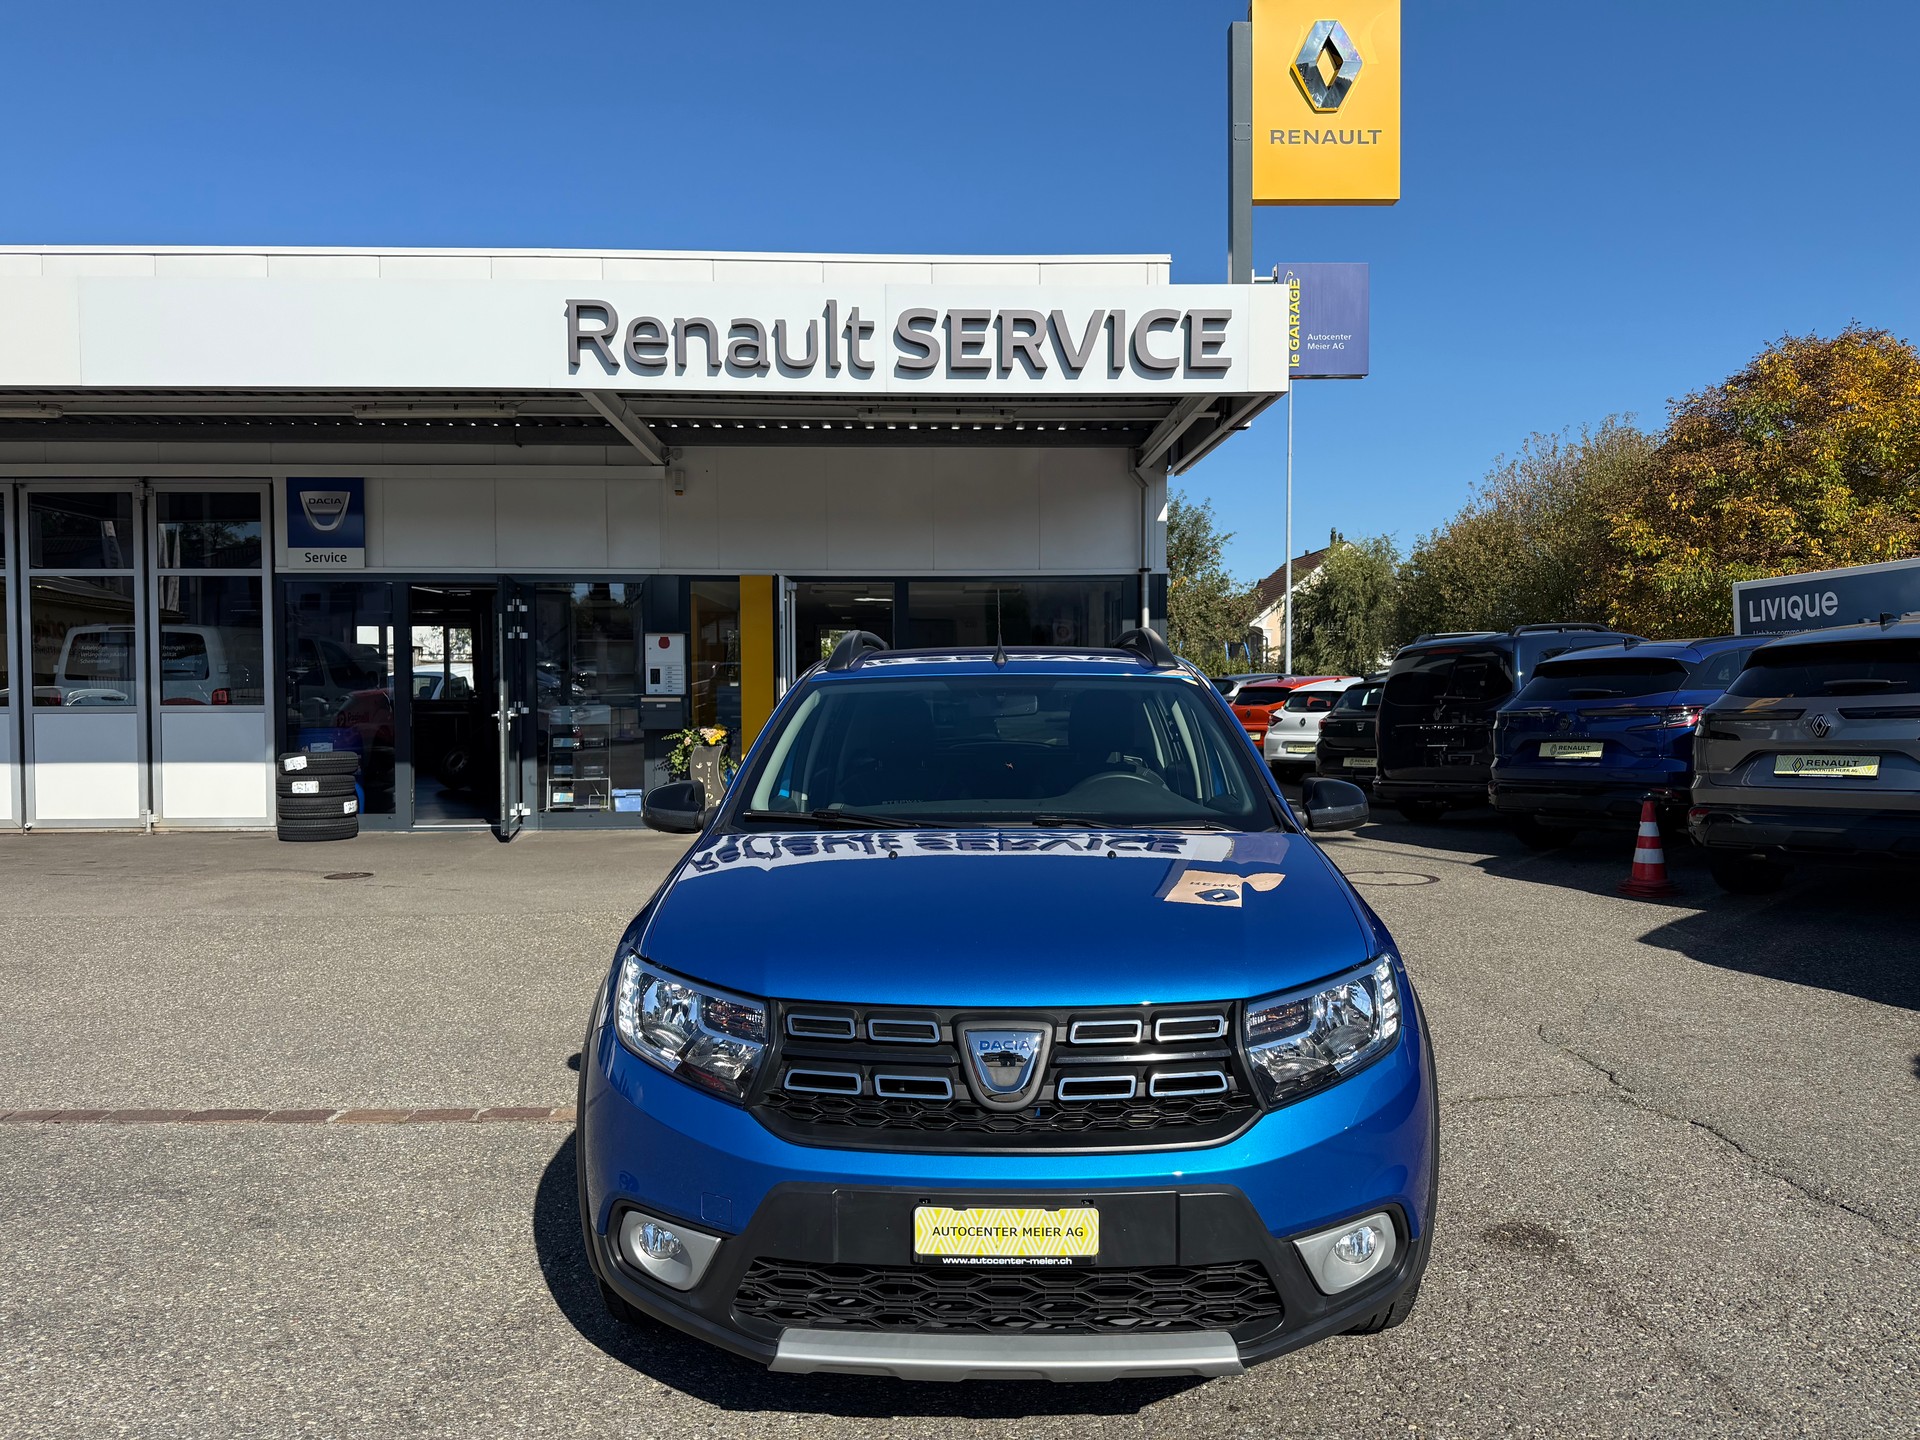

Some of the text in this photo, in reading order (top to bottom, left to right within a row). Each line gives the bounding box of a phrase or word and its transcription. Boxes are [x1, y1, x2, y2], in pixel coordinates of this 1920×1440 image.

[1270, 129, 1382, 145] RENAULT
[1289, 277, 1300, 367] le GARAGE
[565, 299, 1232, 372] Renault SERVICE
[1307, 333, 1352, 341] Autocenter
[1307, 342, 1345, 350] Meier AG
[308, 497, 342, 505] DACIA
[304, 551, 347, 563] Service
[1806, 759, 1860, 767] RENAULT
[979, 1040, 1031, 1051] DACIA
[932, 1226, 1084, 1238] AUTOCENTER MEIER AG
[942, 1256, 1073, 1266] www.autocenter-meier.ch
